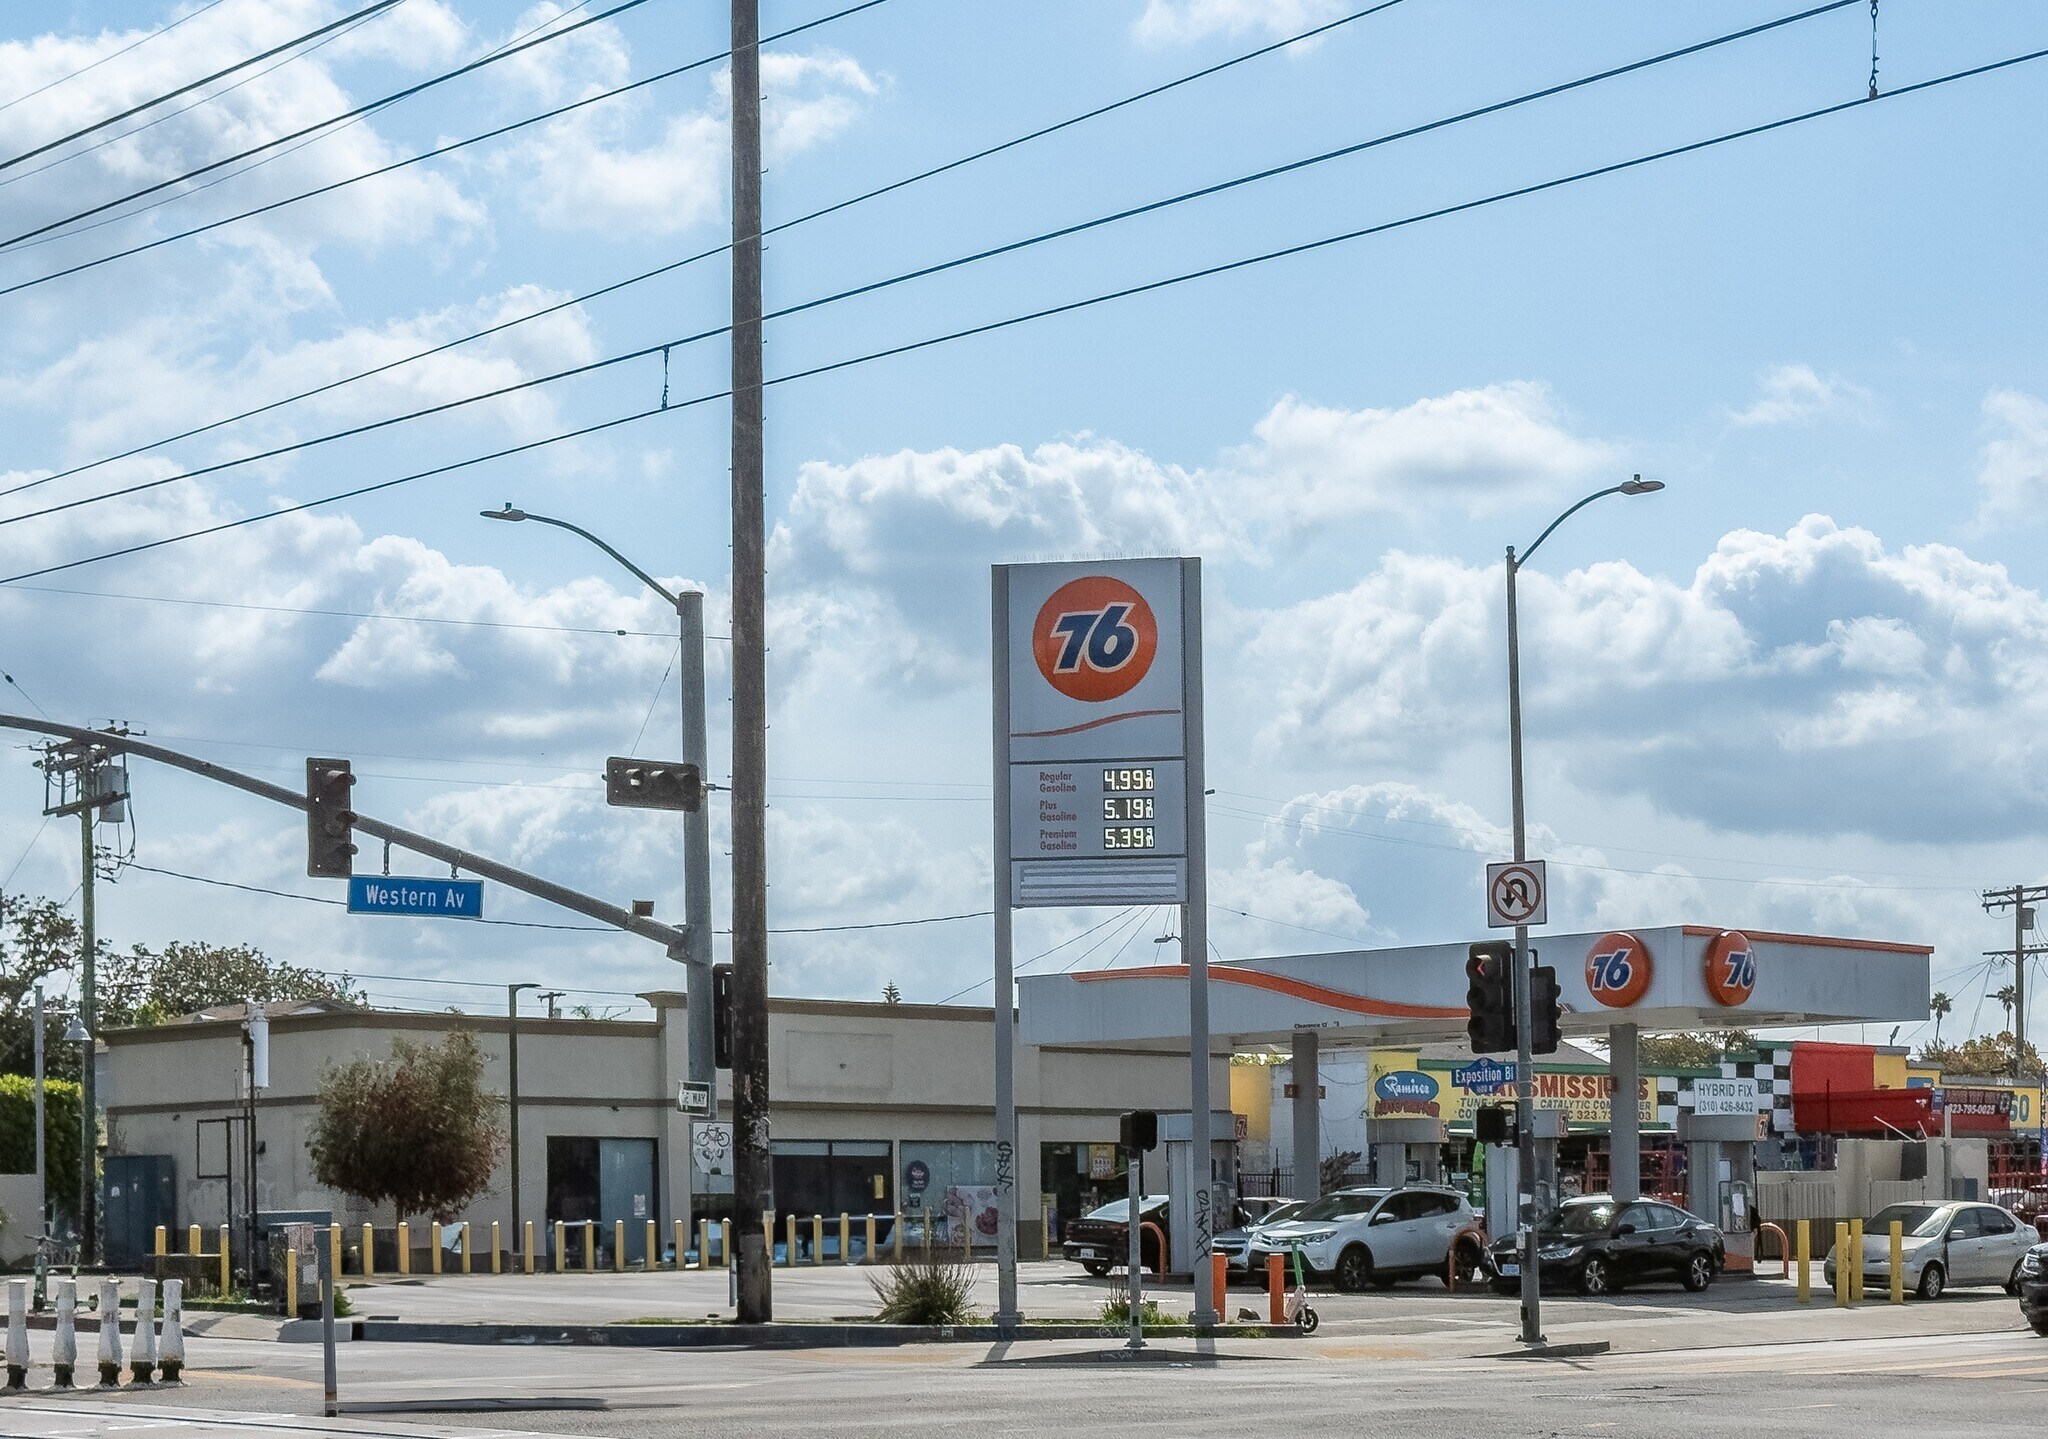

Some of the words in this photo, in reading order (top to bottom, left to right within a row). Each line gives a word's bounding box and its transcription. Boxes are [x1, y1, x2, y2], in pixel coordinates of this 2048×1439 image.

[1050, 602, 1139, 674] 76
[1039, 770, 1072, 783] Regular
[1104, 770, 1143, 790] 4.99
[1039, 783, 1077, 793] Gasoline
[1039, 800, 1058, 810] Plus
[1104, 799, 1143, 819] 5.19
[1039, 812, 1077, 821] Gasoline
[1039, 829, 1077, 839] Premium
[1105, 828, 1144, 848] 5.39
[1039, 841, 1077, 851] Gasoline
[366, 884, 437, 907] Western
[445, 888, 465, 908] Av
[1589, 948, 1633, 991] 76
[1455, 1067, 1502, 1085] Exposition
[1504, 1066, 1514, 1081] Bl
[1698, 1083, 1735, 1097] HYBRID
[1738, 1084, 1753, 1097] FIX
[1541, 1099, 1591, 1109] CATALYTIC
[1699, 1100, 1717, 1113] (310)
